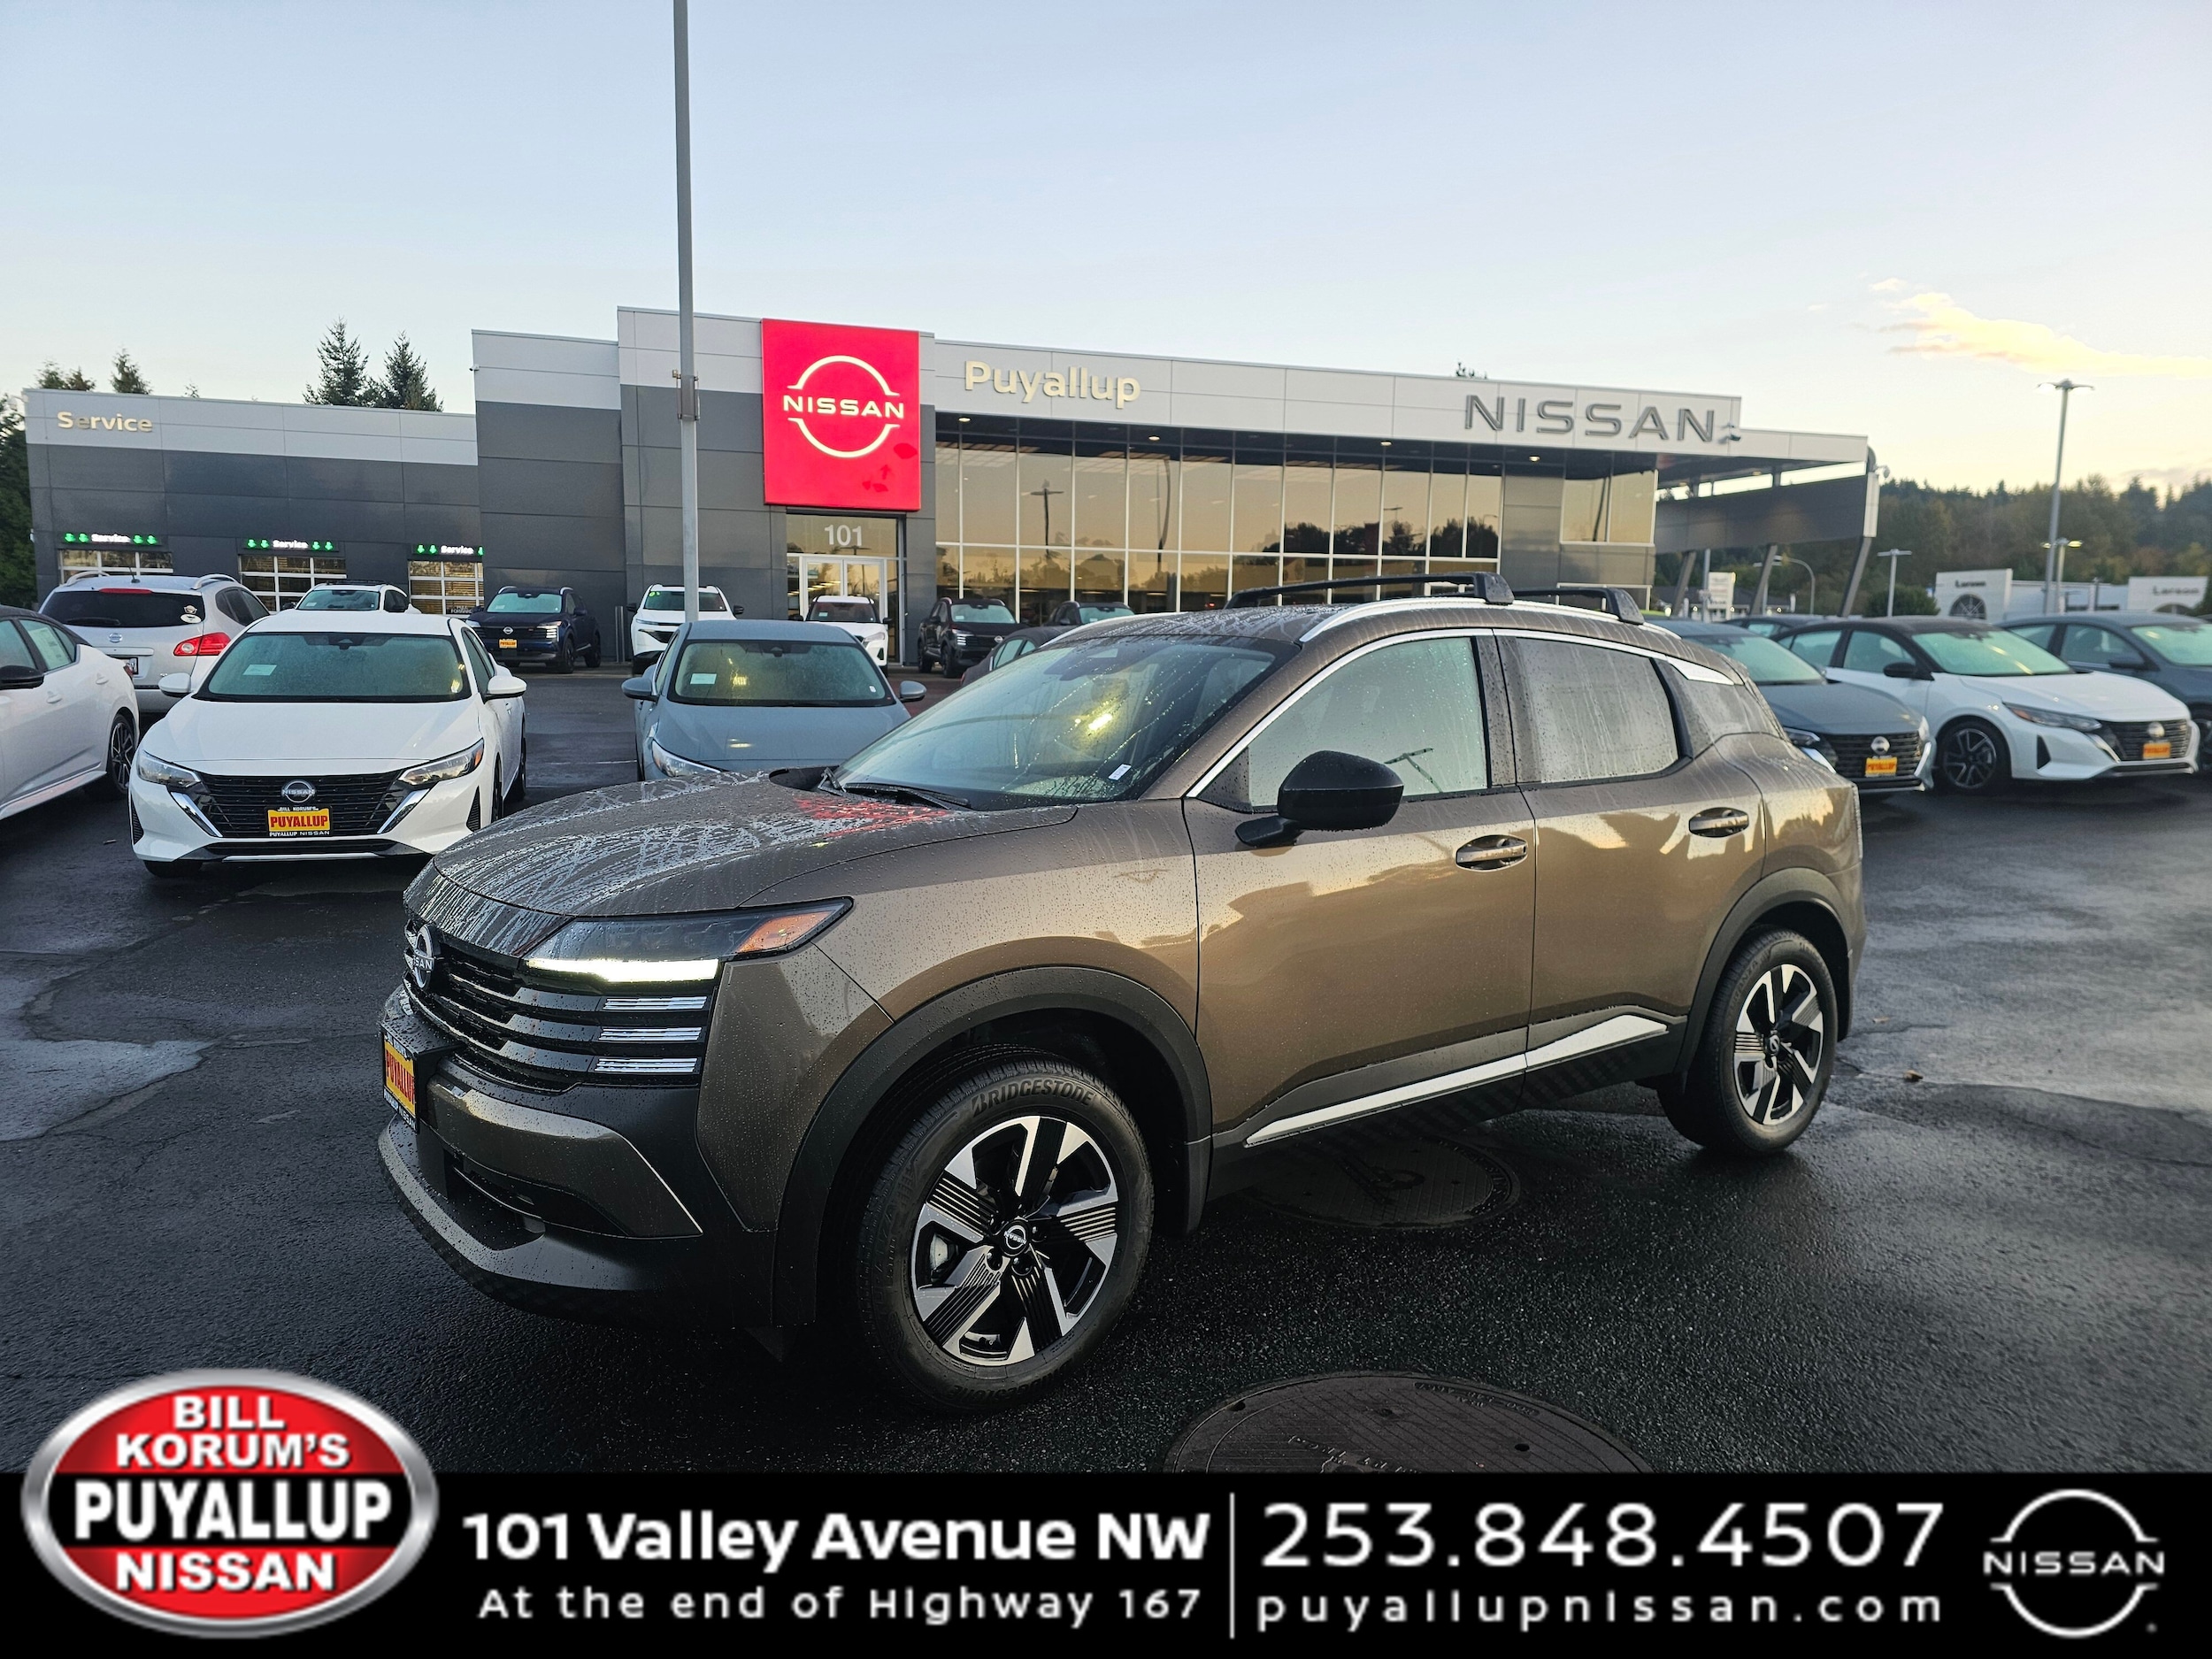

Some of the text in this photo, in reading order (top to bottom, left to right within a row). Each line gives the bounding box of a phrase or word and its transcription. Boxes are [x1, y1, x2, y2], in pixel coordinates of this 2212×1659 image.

[964, 360, 1141, 409] Puyallup
[783, 395, 904, 419] NISSAN
[1464, 395, 1715, 442] NISSAN
[57, 411, 153, 433] Service
[824, 524, 863, 547] 101
[270, 816, 328, 828] PUYALLUP
[971, 1078, 1095, 1118] BRIDGESTONE
